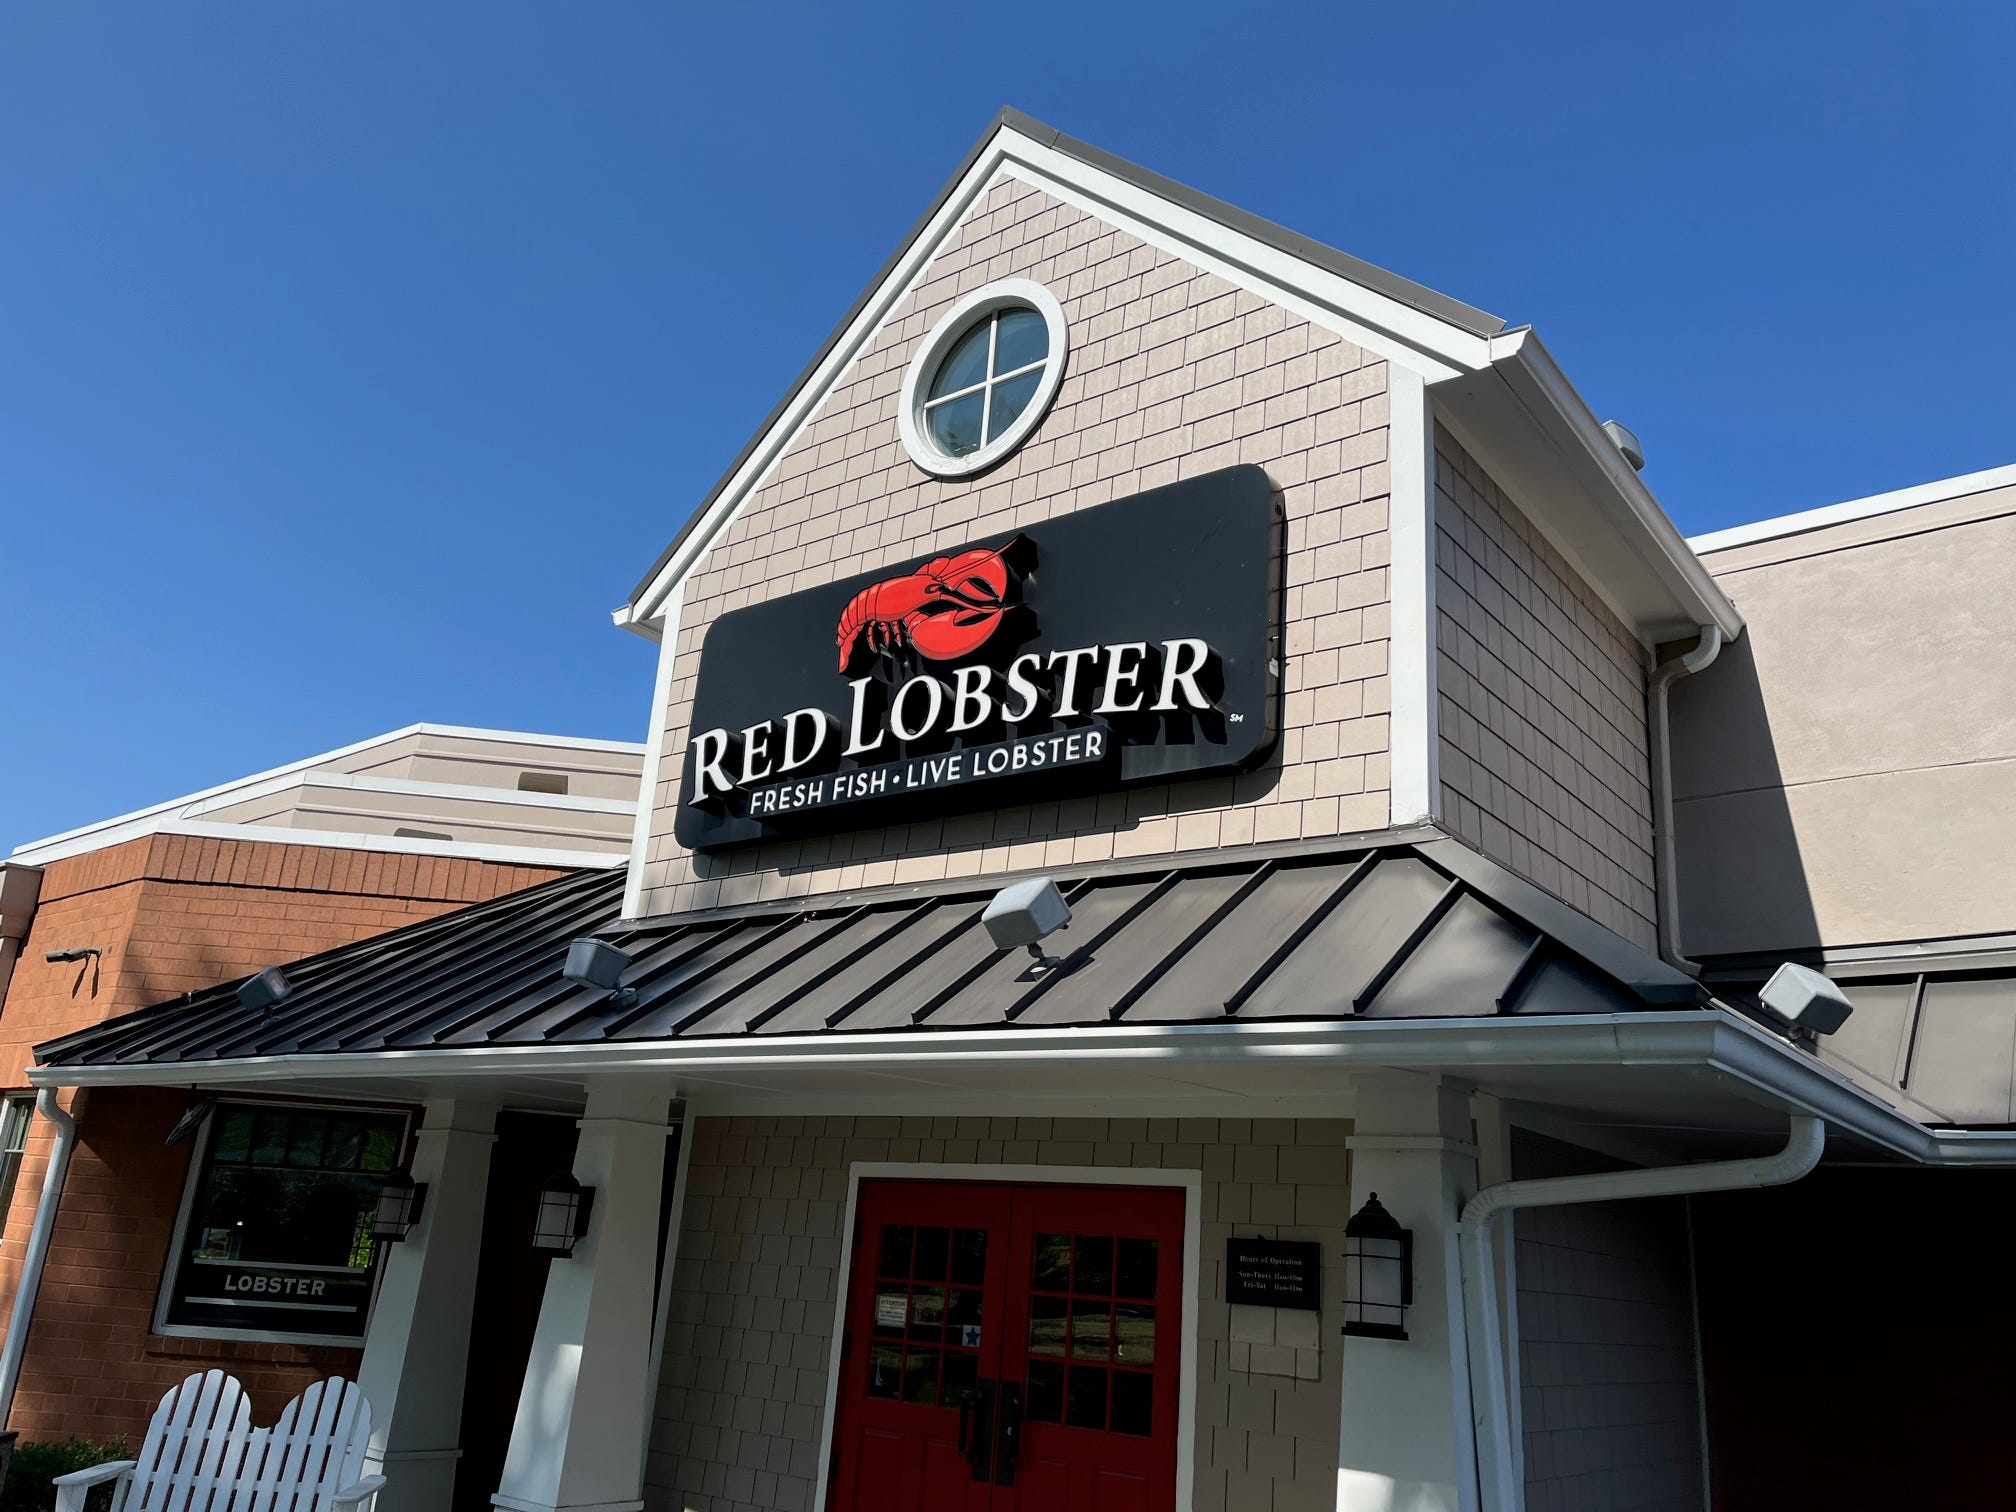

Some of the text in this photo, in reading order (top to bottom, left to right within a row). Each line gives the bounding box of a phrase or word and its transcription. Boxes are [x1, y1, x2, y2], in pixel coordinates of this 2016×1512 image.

[688, 638, 1211, 806] RED LOBSTER
[1229, 713, 1244, 723] SM
[750, 731, 1103, 815] FRESH FISH LIVE LOBSTER
[1239, 1255, 1303, 1267] Hours of Operation
[224, 1274, 326, 1296] LOBSTER
